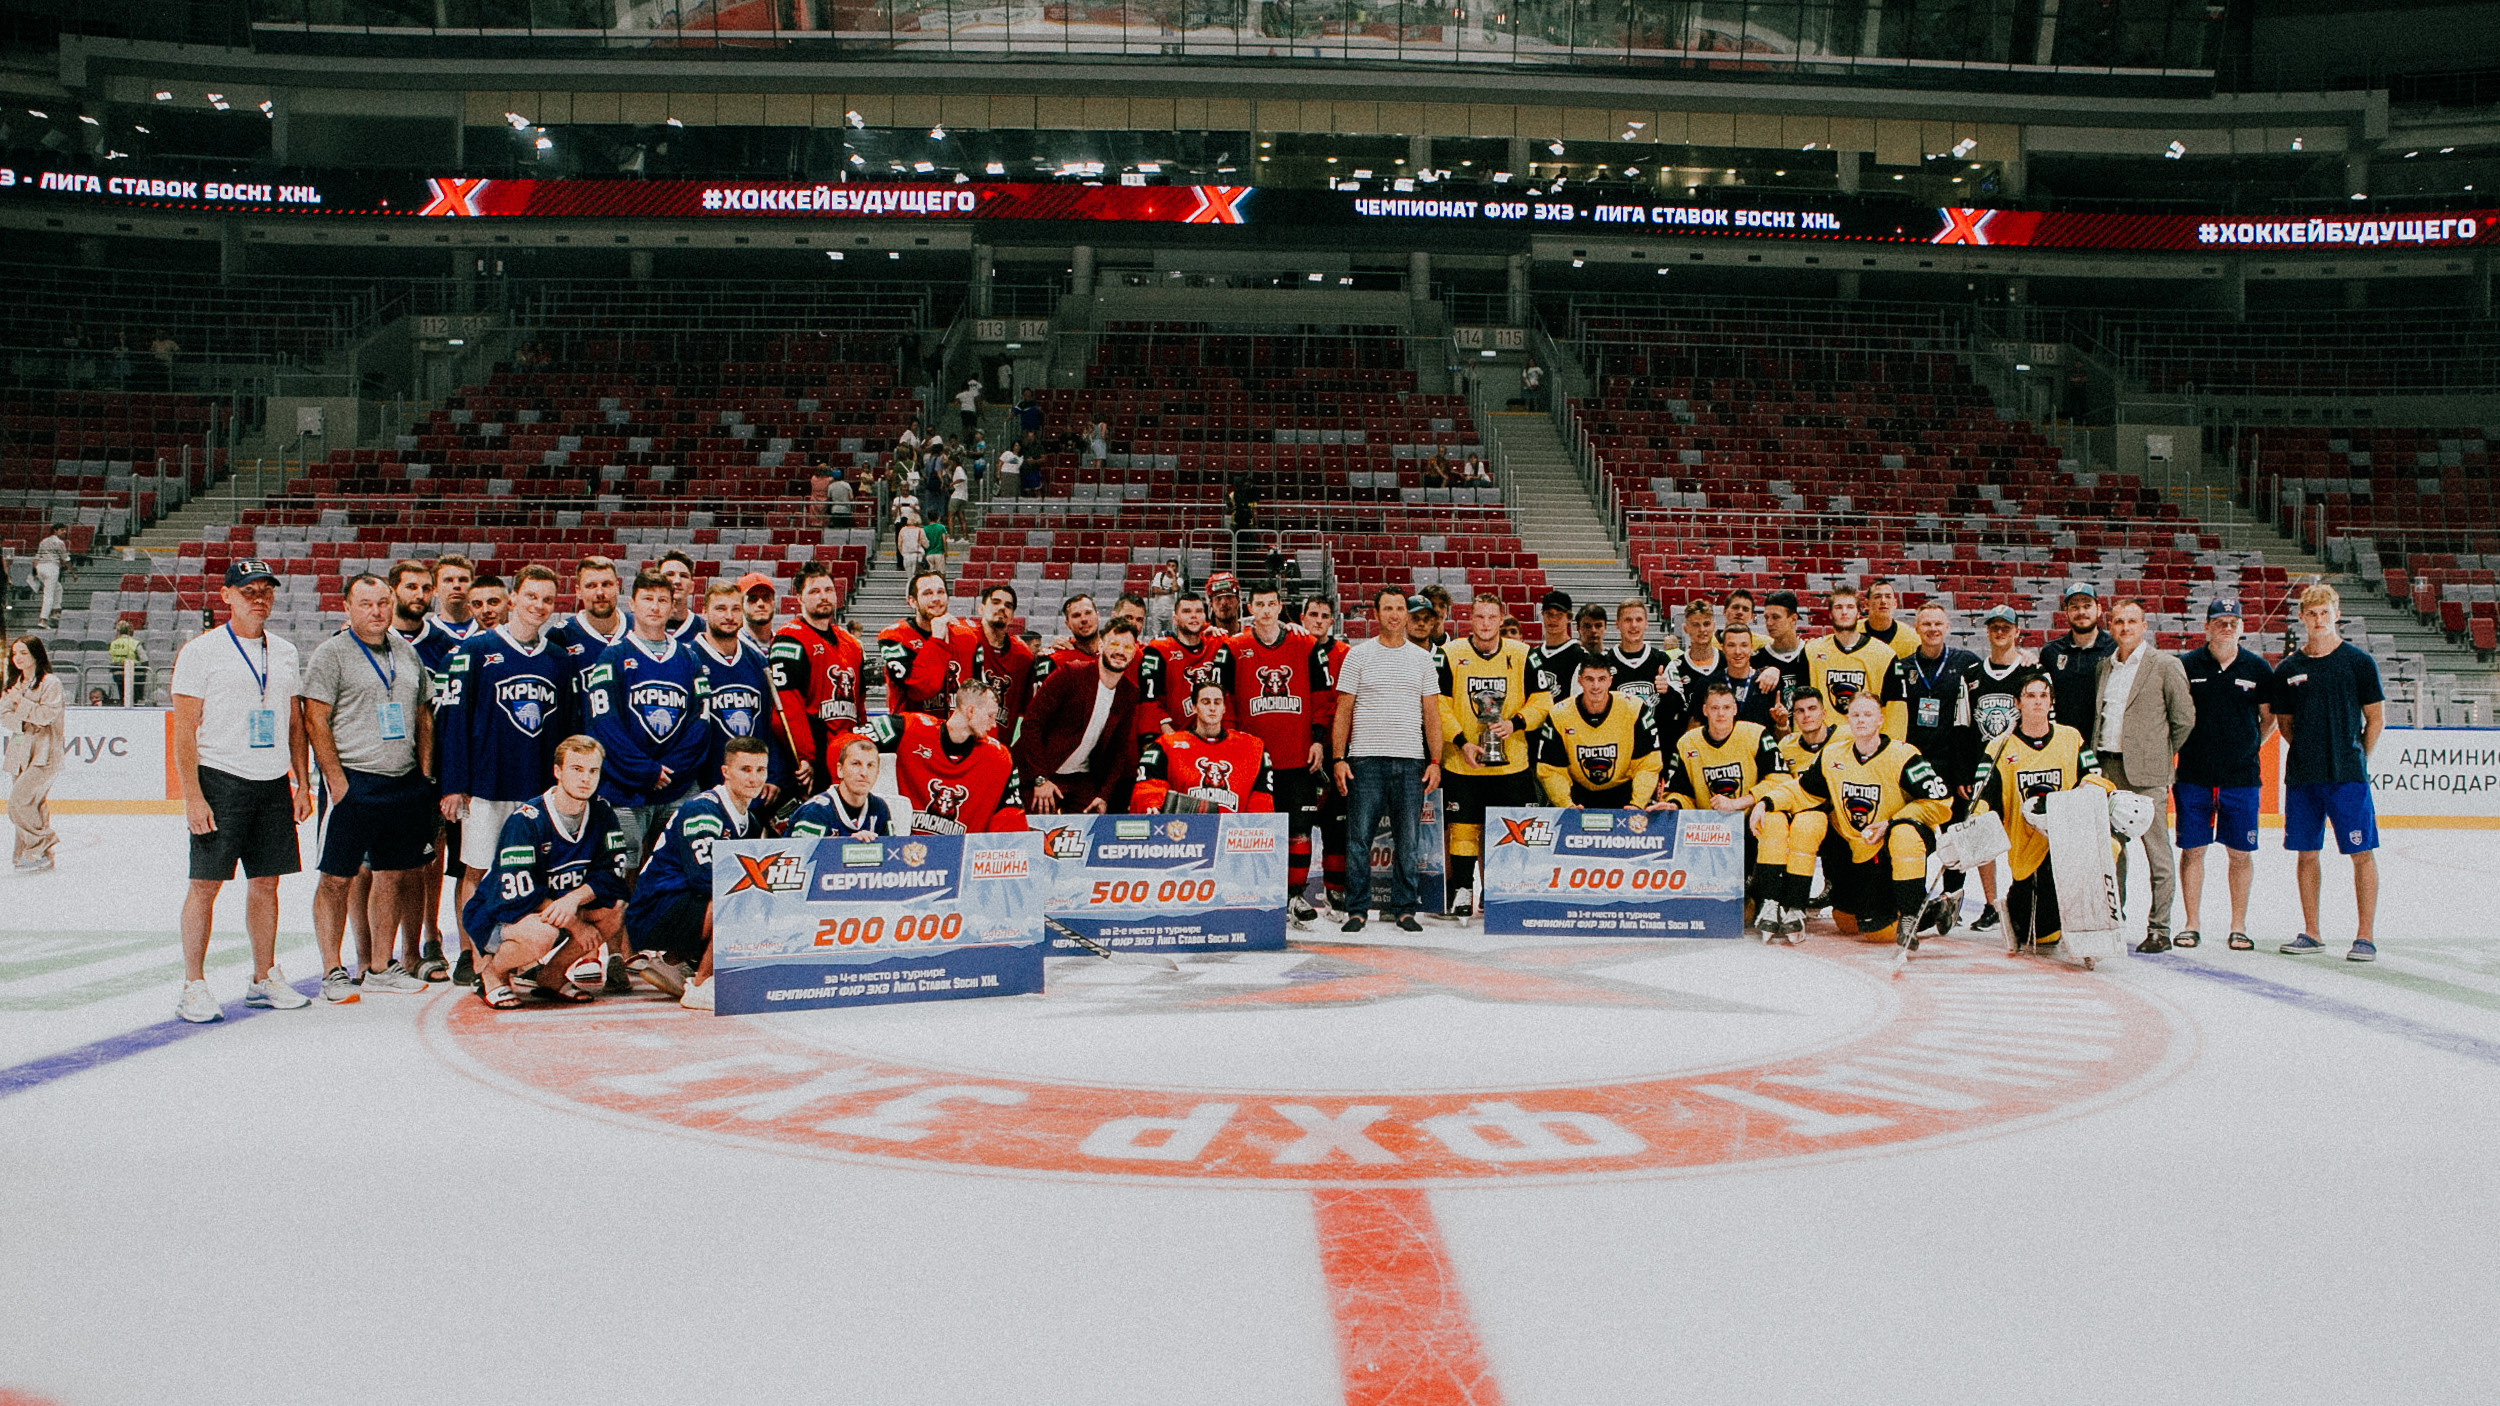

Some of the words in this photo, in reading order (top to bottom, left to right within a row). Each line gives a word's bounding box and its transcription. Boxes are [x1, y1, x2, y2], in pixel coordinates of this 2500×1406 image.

[40, 172, 102, 193] ЛИГА
[108, 177, 198, 199] СТАВОК
[205, 183, 272, 202] SOCHI
[278, 186, 321, 203] XHL
[702, 186, 975, 214] #ХОККЕЙБУДУЩЕГО
[1354, 198, 1478, 219] ЧЕМПИОНАТ
[1484, 201, 1528, 220] ФХР
[1593, 204, 1646, 223] ЛИГА
[1651, 207, 1728, 226] СТАВОК
[1735, 210, 1795, 228] SOCHI
[1801, 212, 1840, 229] XHL
[2198, 218, 2477, 246] #ХОККЕЙБУДУЩЕГО
[978, 322, 1004, 337] 113
[1021, 322, 1046, 337] 114
[1456, 329, 1481, 345] 114
[1497, 330, 1522, 346] 115
[1469, 678, 1507, 692] РОСТОВ
[1827, 670, 1864, 685] РОСТОВ
[502, 682, 555, 705] КРЫМ
[633, 688, 687, 709] КРЫМ
[711, 692, 760, 709] КРЫМ
[589, 688, 610, 718] 18
[1251, 699, 1301, 714] КРАСНОДАР
[1578, 745, 1617, 759] РОСТОВ
[2400, 749, 2500, 768] АДМИНИ
[1703, 765, 1741, 783] РОСТОВ
[2019, 771, 2061, 786] РОСТОВ
[1922, 776, 1948, 799] 36
[2367, 773, 2500, 795] КРАСНОДАР
[1842, 785, 1881, 801] РОСТОВ
[1226, 837, 1275, 849] МАШИНА
[1564, 835, 1666, 850] СЕРТИФИКАТ
[1684, 831, 1732, 843] МАШИНА
[974, 850, 1017, 861] КРАСНАЯ
[1097, 843, 1206, 860] СЕРТИФИКАТ
[973, 860, 1029, 876] МАШИНА
[501, 870, 535, 901] 30
[821, 869, 949, 892] СЕРТИФИКАТ
[1549, 867, 1562, 888] 1
[1568, 868, 1624, 889] 000
[1631, 869, 1687, 890] 000
[1090, 880, 1150, 904] 500
[1157, 879, 1216, 903] 000
[813, 916, 885, 947] 200
[893, 913, 963, 943] 000
[859, 971, 891, 982] место
[902, 968, 946, 981] турнире
[766, 986, 837, 1001] ЧЕМПИОНАТ
